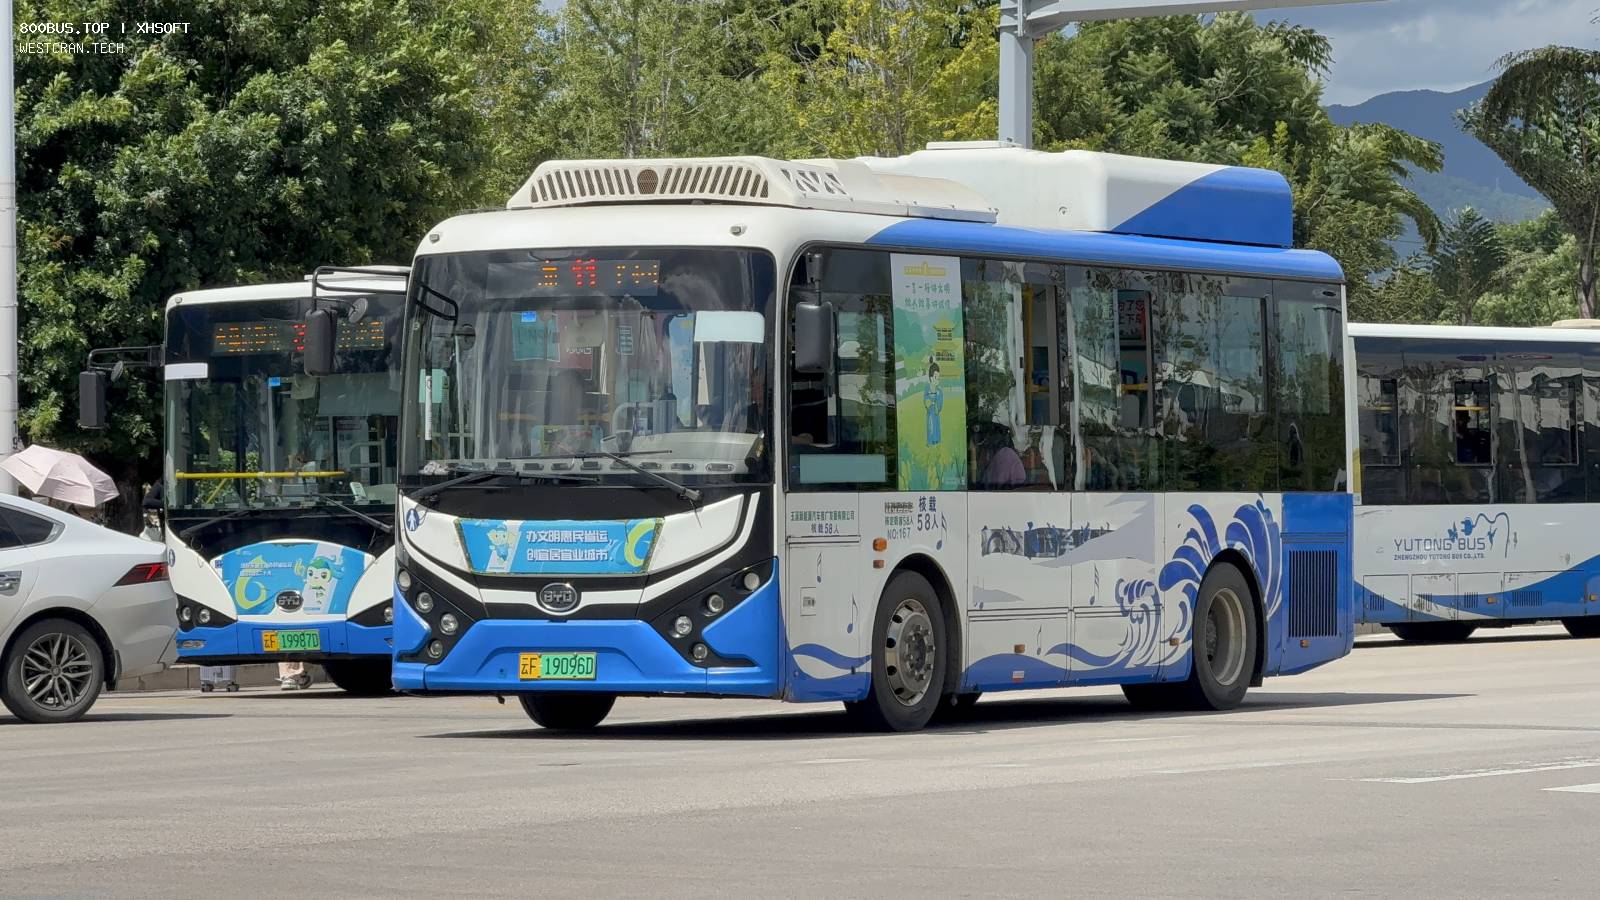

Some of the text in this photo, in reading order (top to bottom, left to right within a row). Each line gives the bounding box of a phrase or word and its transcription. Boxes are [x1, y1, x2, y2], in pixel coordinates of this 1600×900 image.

[917, 513, 939, 531] 58人
[1394, 537, 1486, 552] YUTONG BUS
[543, 590, 573, 603] BYD
